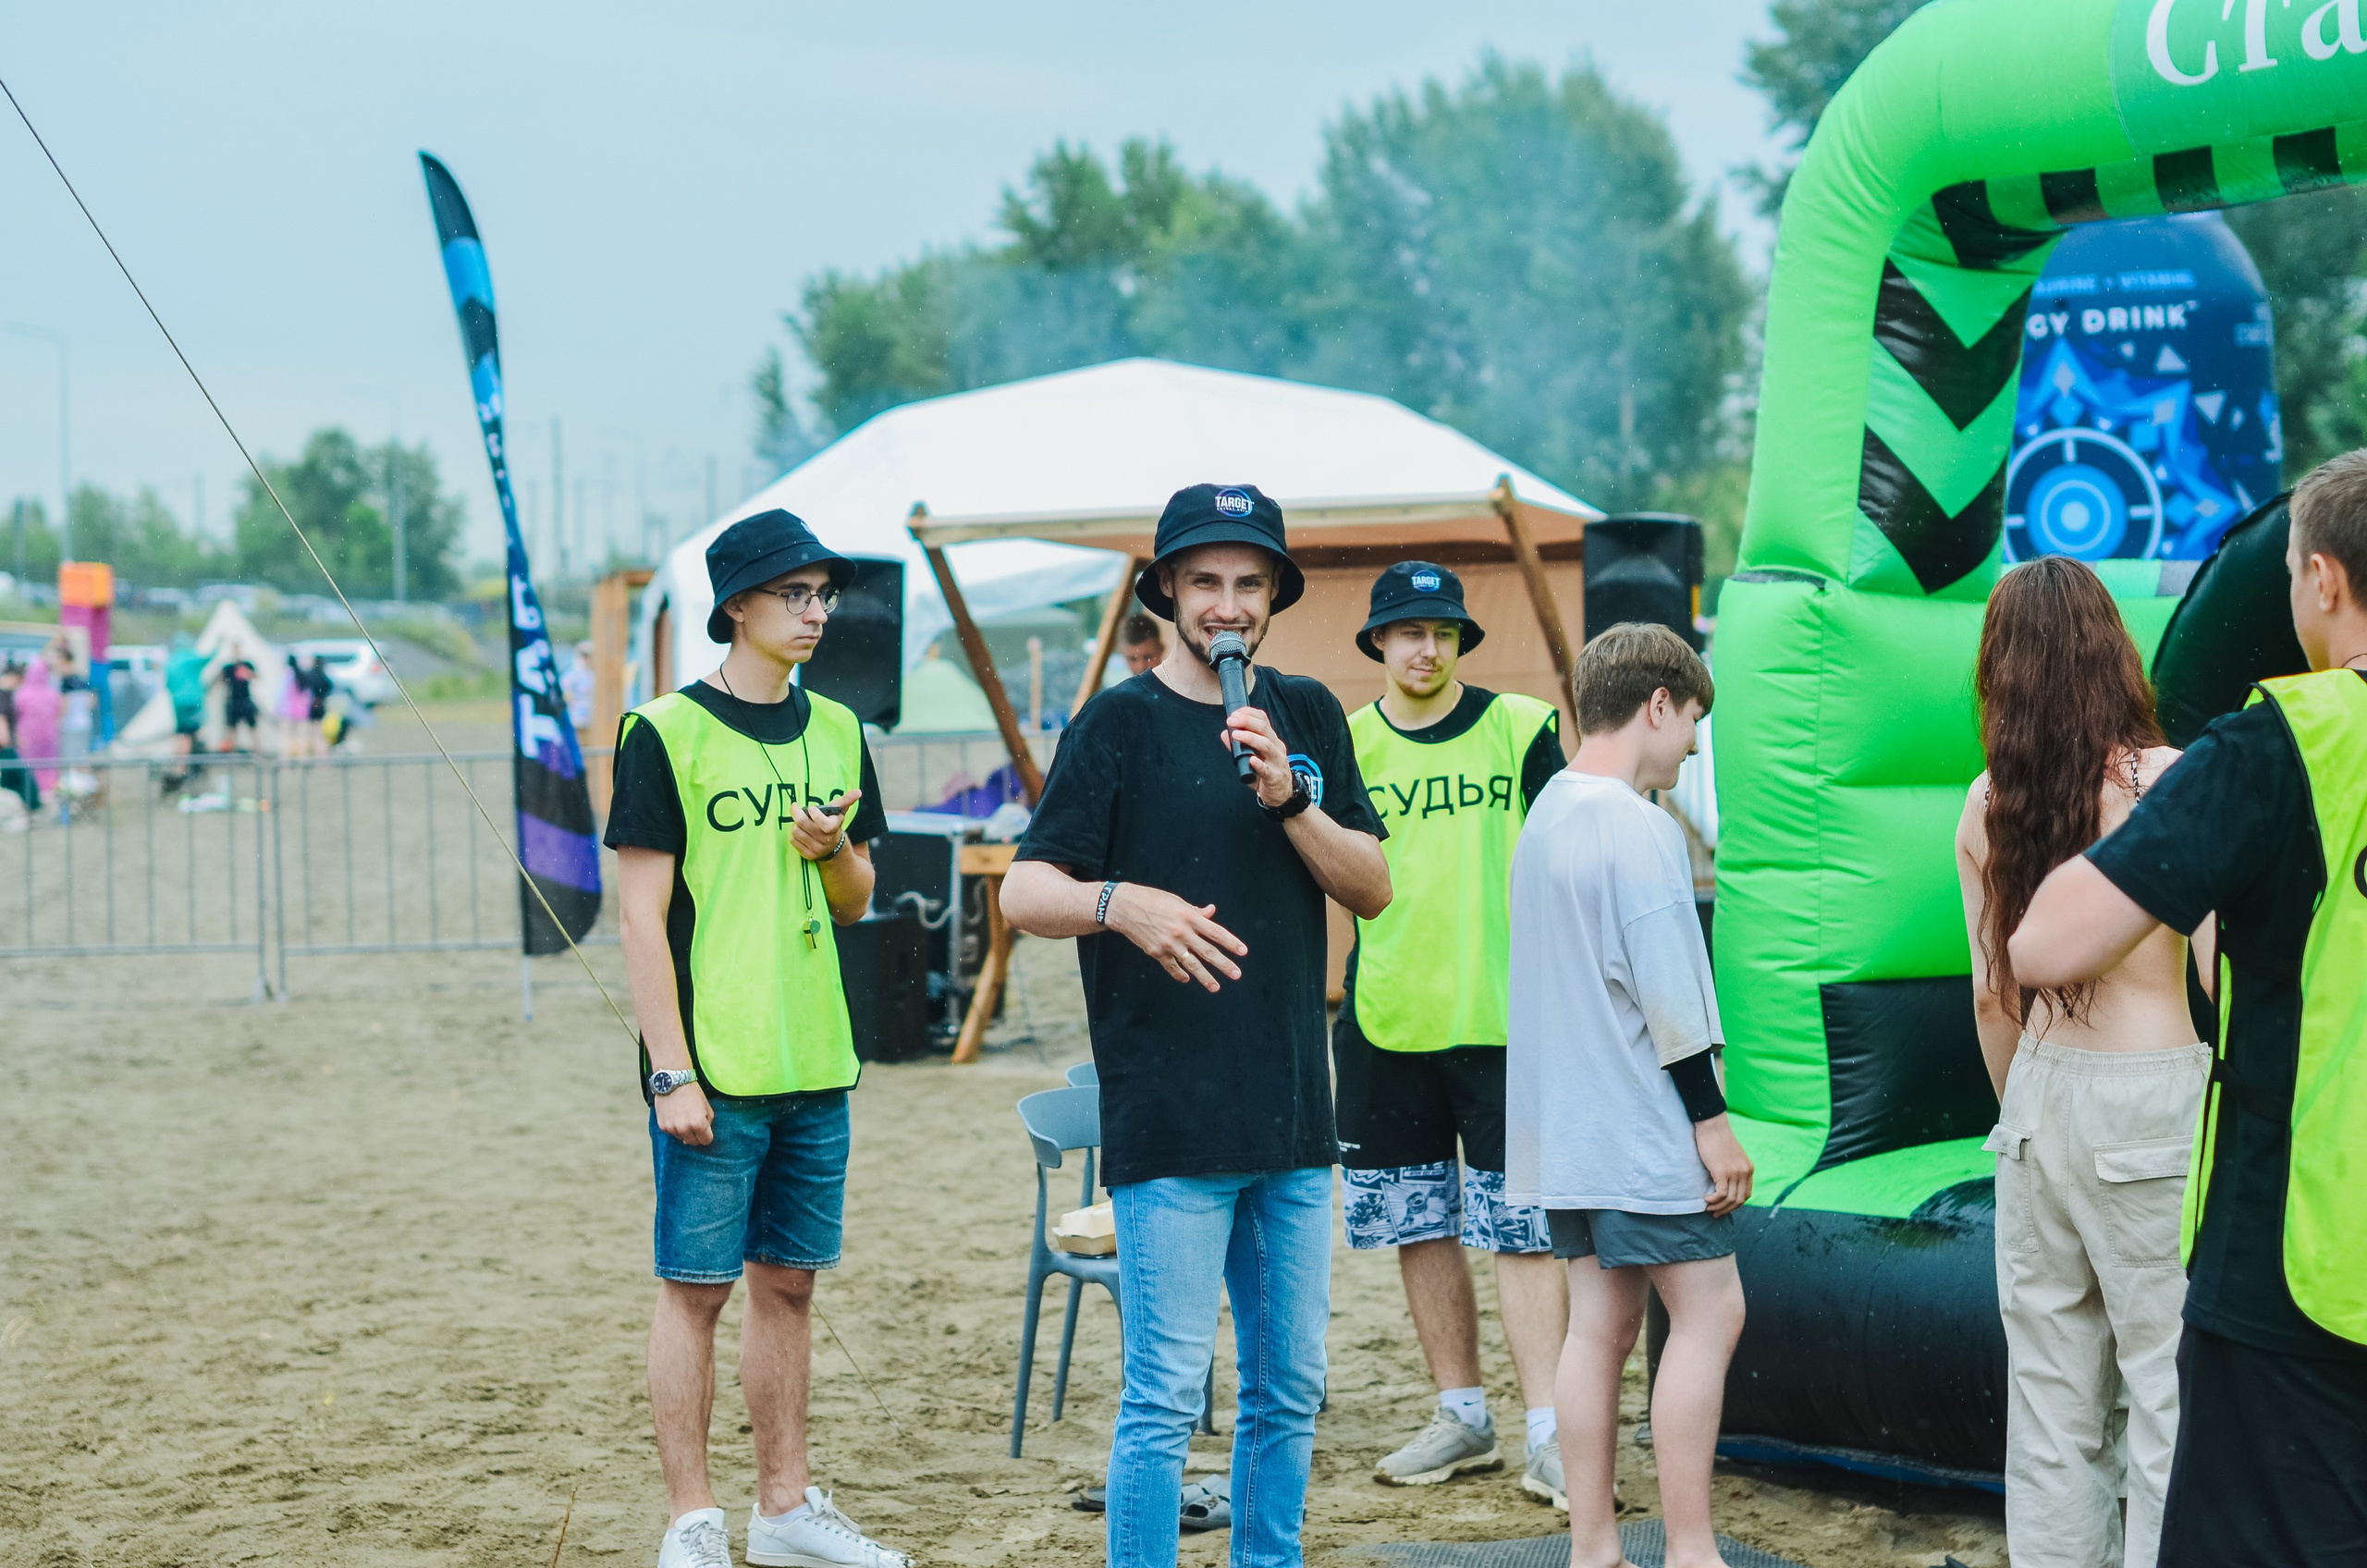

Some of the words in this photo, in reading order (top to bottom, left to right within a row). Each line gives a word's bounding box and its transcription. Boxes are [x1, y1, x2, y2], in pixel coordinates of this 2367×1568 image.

[2081, 303, 2189, 335] DRINK
[1215, 496, 1253, 512] TARGET
[1412, 575, 1441, 586] TARGET
[706, 782, 845, 832] СУДЬ
[1367, 774, 1514, 819] СУДЬЯ
